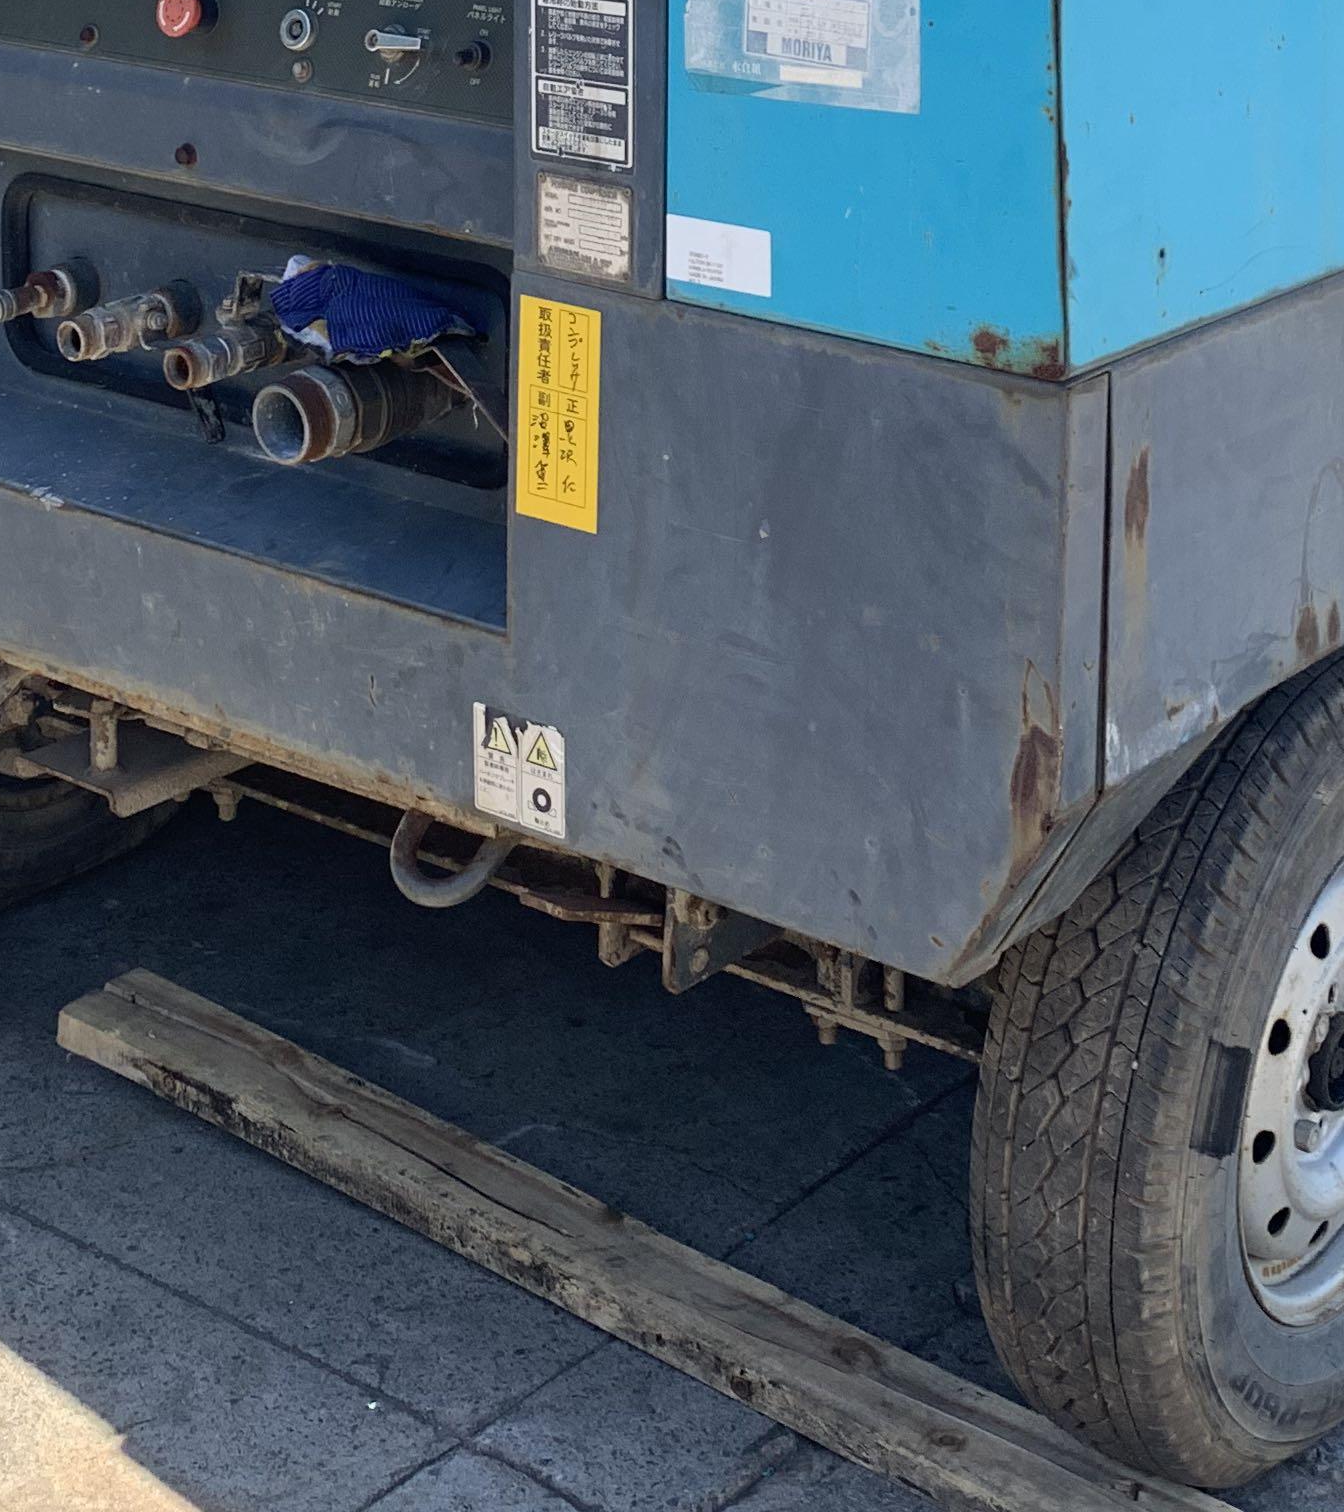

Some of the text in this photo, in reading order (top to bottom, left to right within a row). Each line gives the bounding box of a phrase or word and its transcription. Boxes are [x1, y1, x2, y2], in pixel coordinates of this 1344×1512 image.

[466, 11, 506, 24] パネルライト
[781, 36, 833, 63] MORIYA
[537, 306, 552, 385] 取扱責任者
[538, 391, 551, 407] 副
[567, 398, 579, 414] 正
